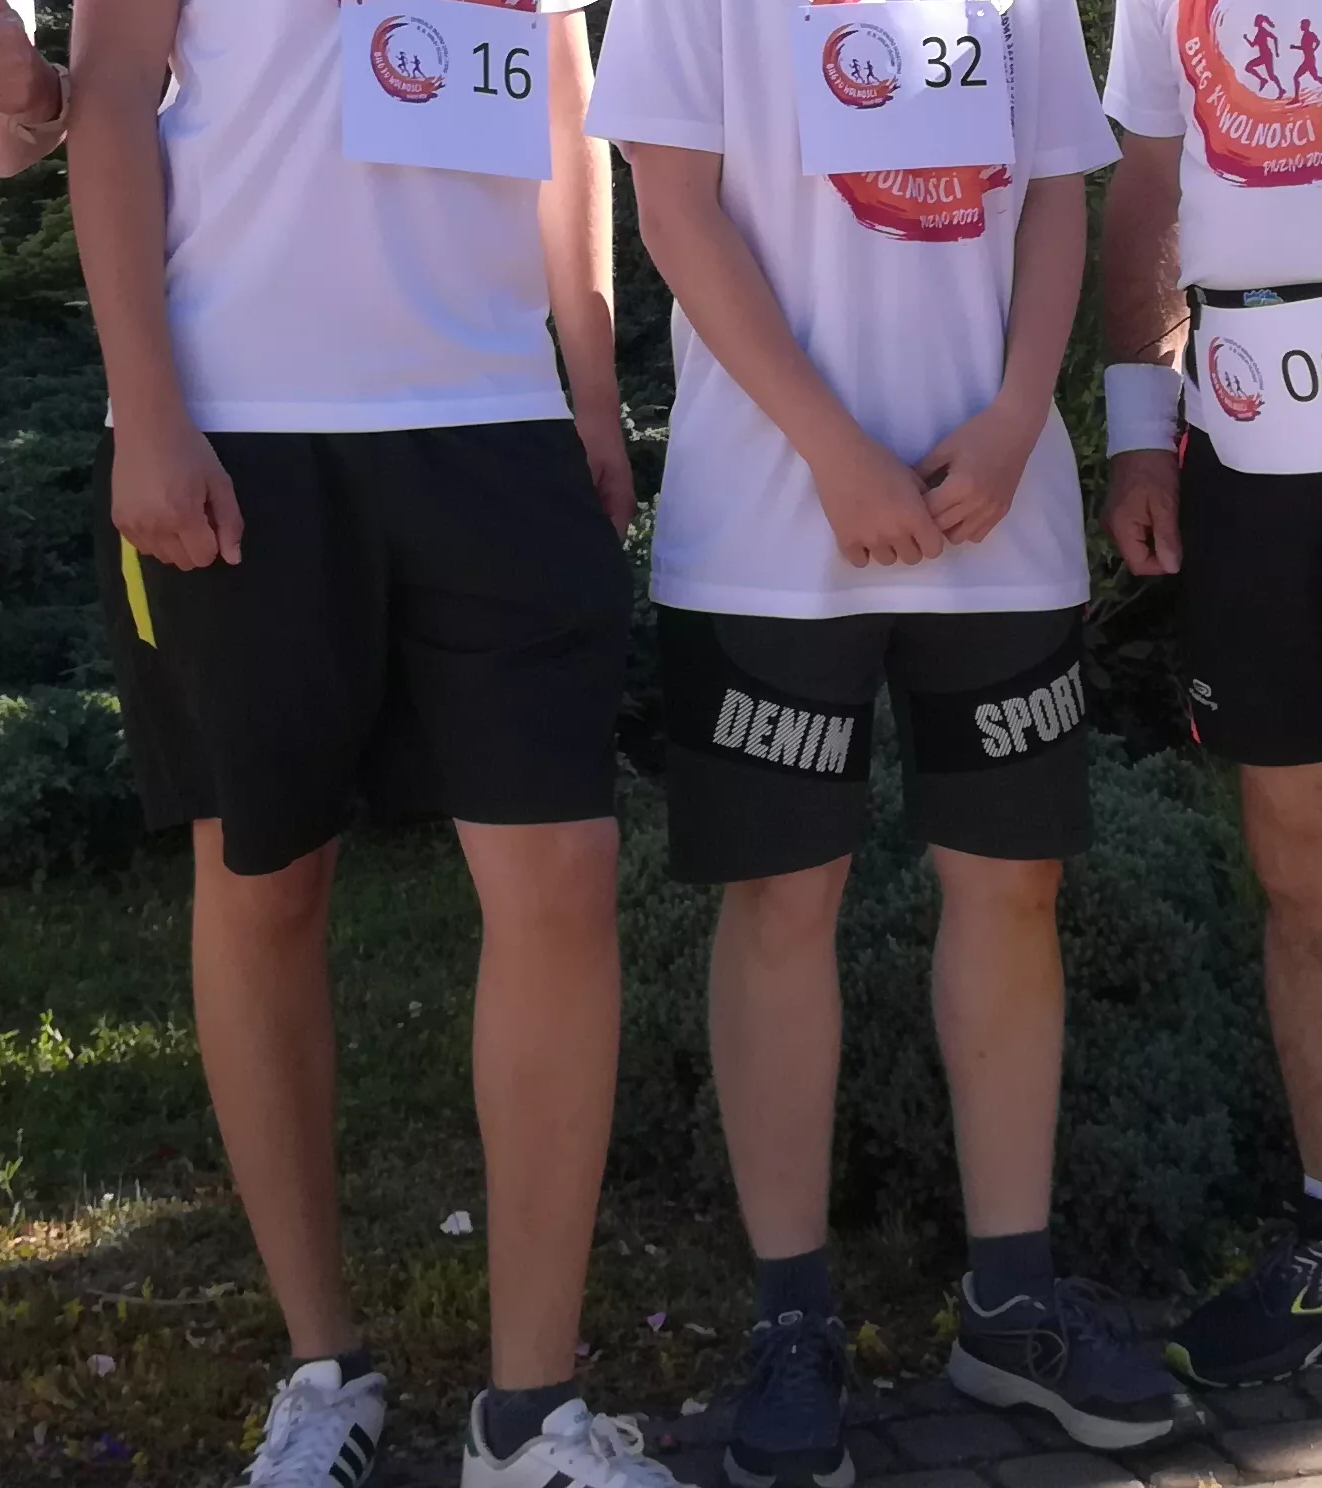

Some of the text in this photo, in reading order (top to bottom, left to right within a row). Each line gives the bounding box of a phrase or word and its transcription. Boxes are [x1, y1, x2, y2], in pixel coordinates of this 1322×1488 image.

[473, 42, 531, 100] 16
[922, 35, 988, 88] 32
[1185, 36, 1213, 90] BIEG
[712, 687, 855, 774] DENIM
